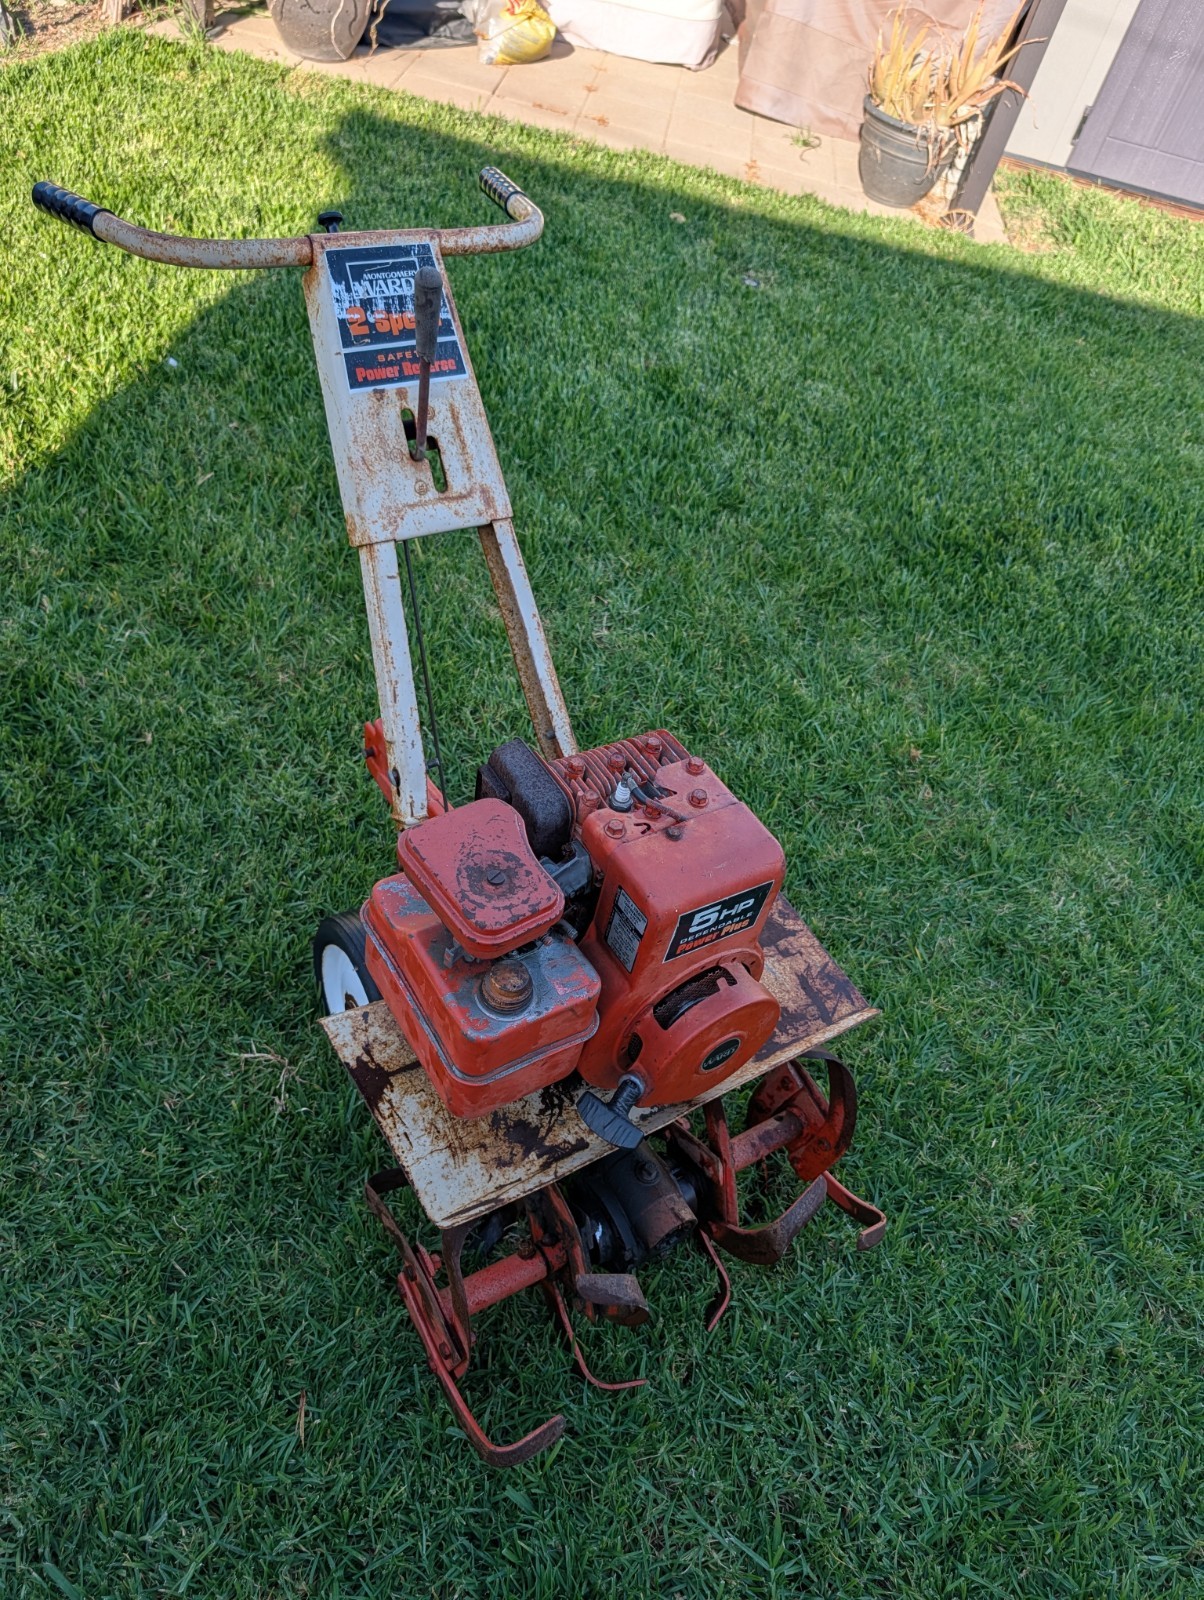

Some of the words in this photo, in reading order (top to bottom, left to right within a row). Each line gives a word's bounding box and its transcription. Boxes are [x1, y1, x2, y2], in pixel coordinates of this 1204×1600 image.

[362, 270, 417, 281] MONTGOMERY
[346, 306, 370, 335] 2
[377, 350, 420, 362] SAFET
[355, 365, 400, 382] Power
[402, 359, 457, 376] Reerse
[675, 931, 719, 954] Power
[720, 919, 750, 936] Plus
[680, 911, 754, 944] DEPENDABLE
